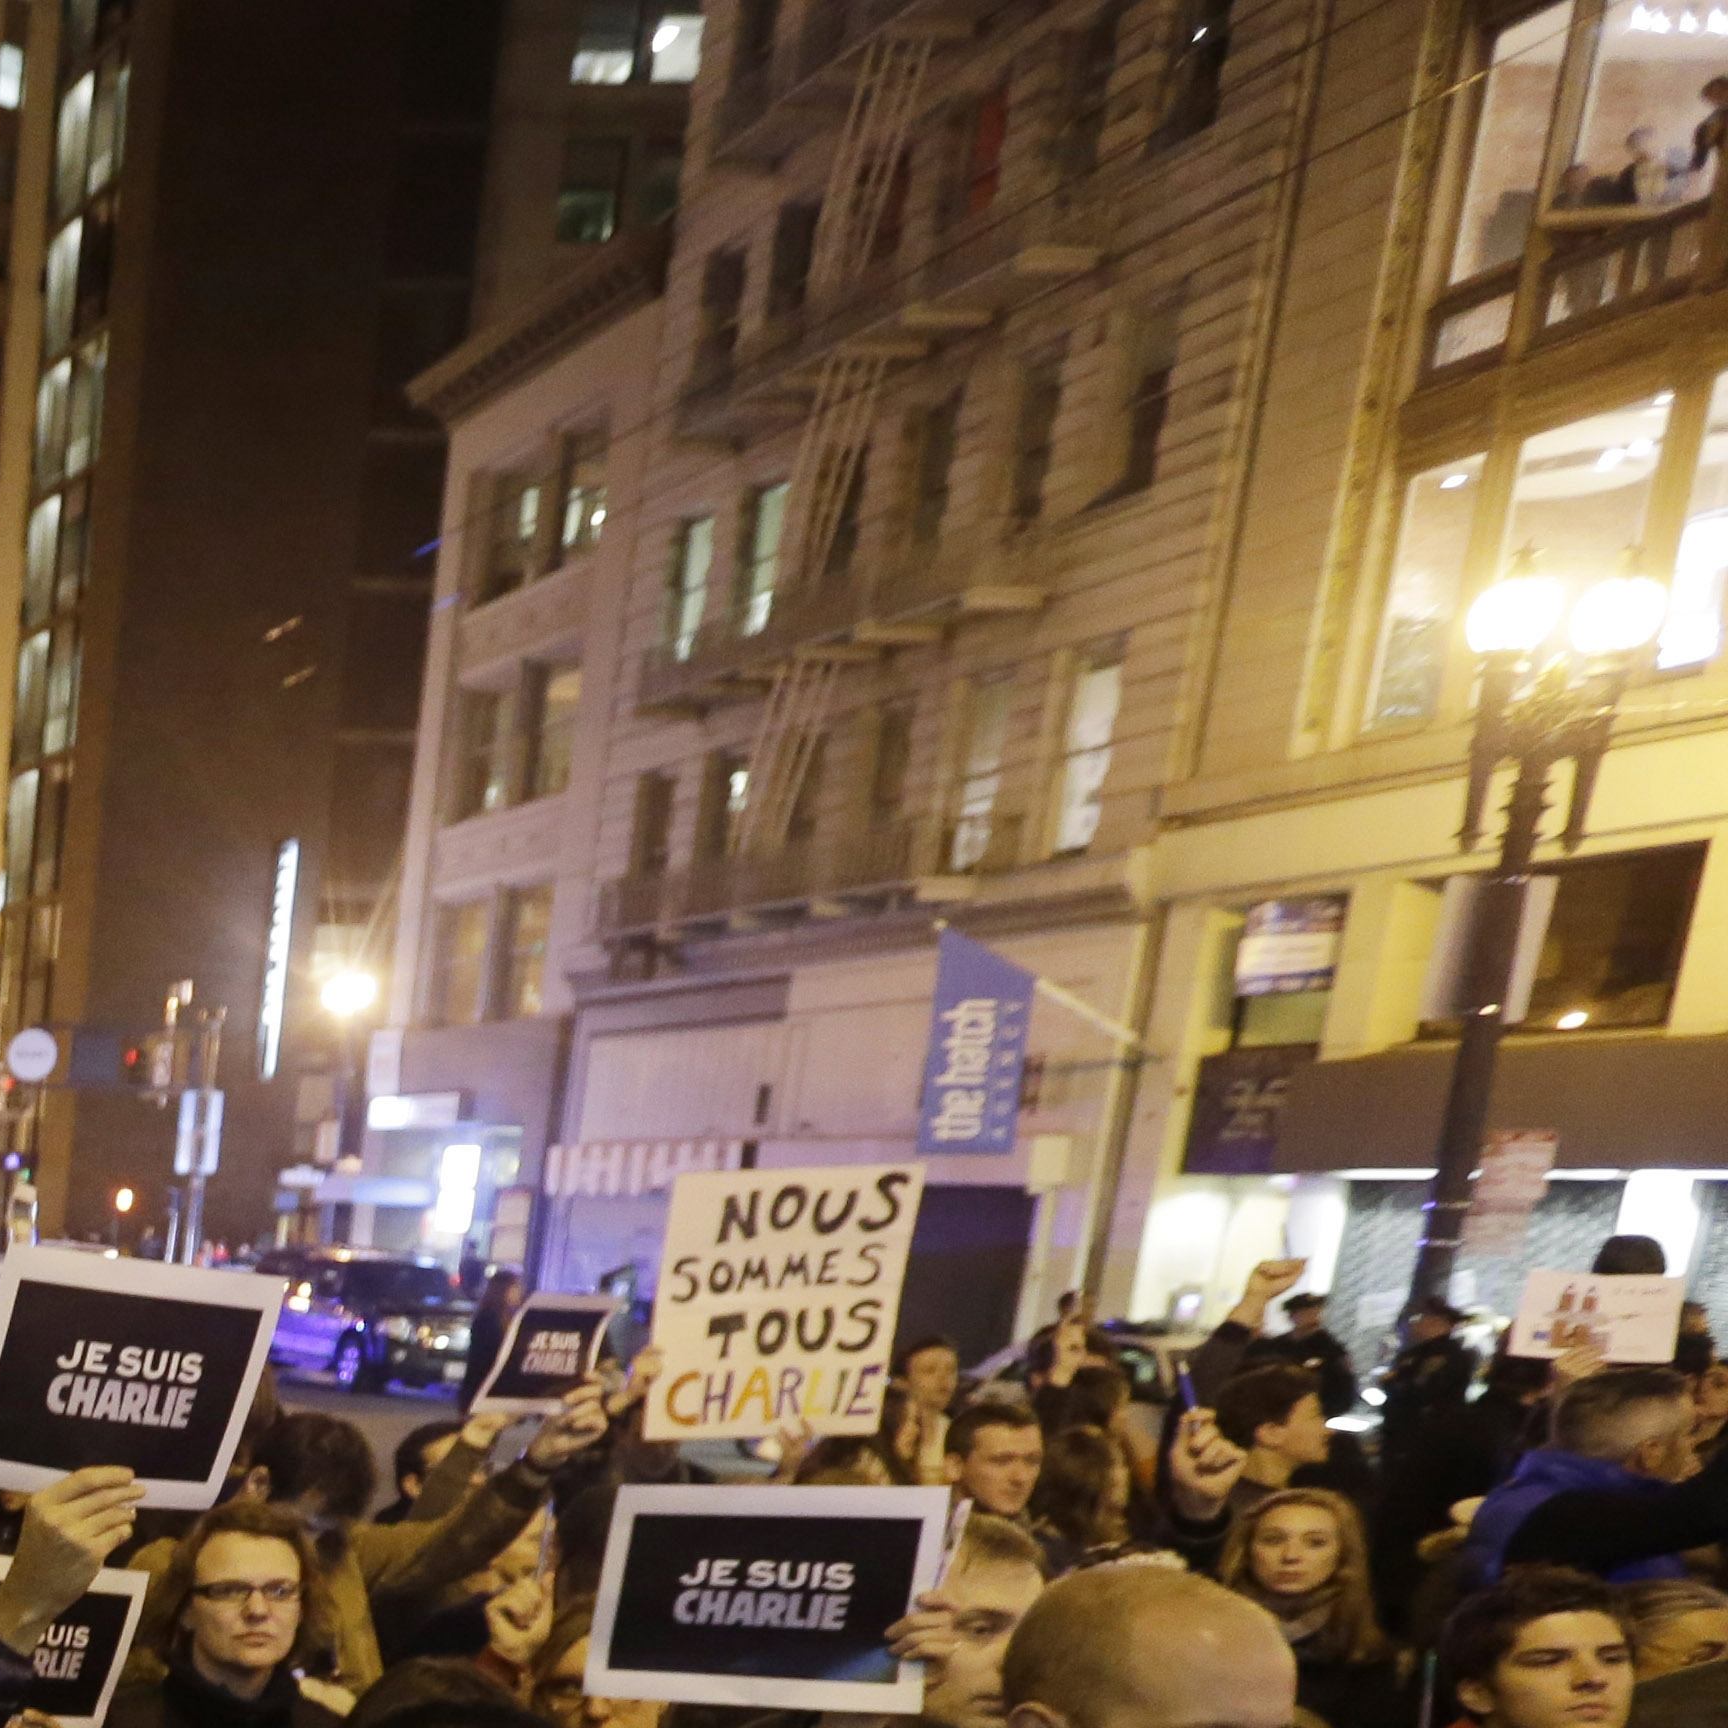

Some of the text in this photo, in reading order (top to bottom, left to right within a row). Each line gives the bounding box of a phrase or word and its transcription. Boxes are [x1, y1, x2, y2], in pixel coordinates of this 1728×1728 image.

[714, 1171, 911, 1244] NOUS
[670, 1243, 887, 1304] SOMMES
[706, 1299, 883, 1360] TOUS
[55, 1339, 204, 1385] JE SUIS
[45, 1371, 198, 1430] CHARLIE
[665, 1365, 883, 1427] CHARLIE
[678, 1558, 856, 1591] JE SUIS
[672, 1588, 852, 1632] CHARLIE
[37, 1624, 91, 1649] UIS
[32, 1648, 86, 1681] RLIE
